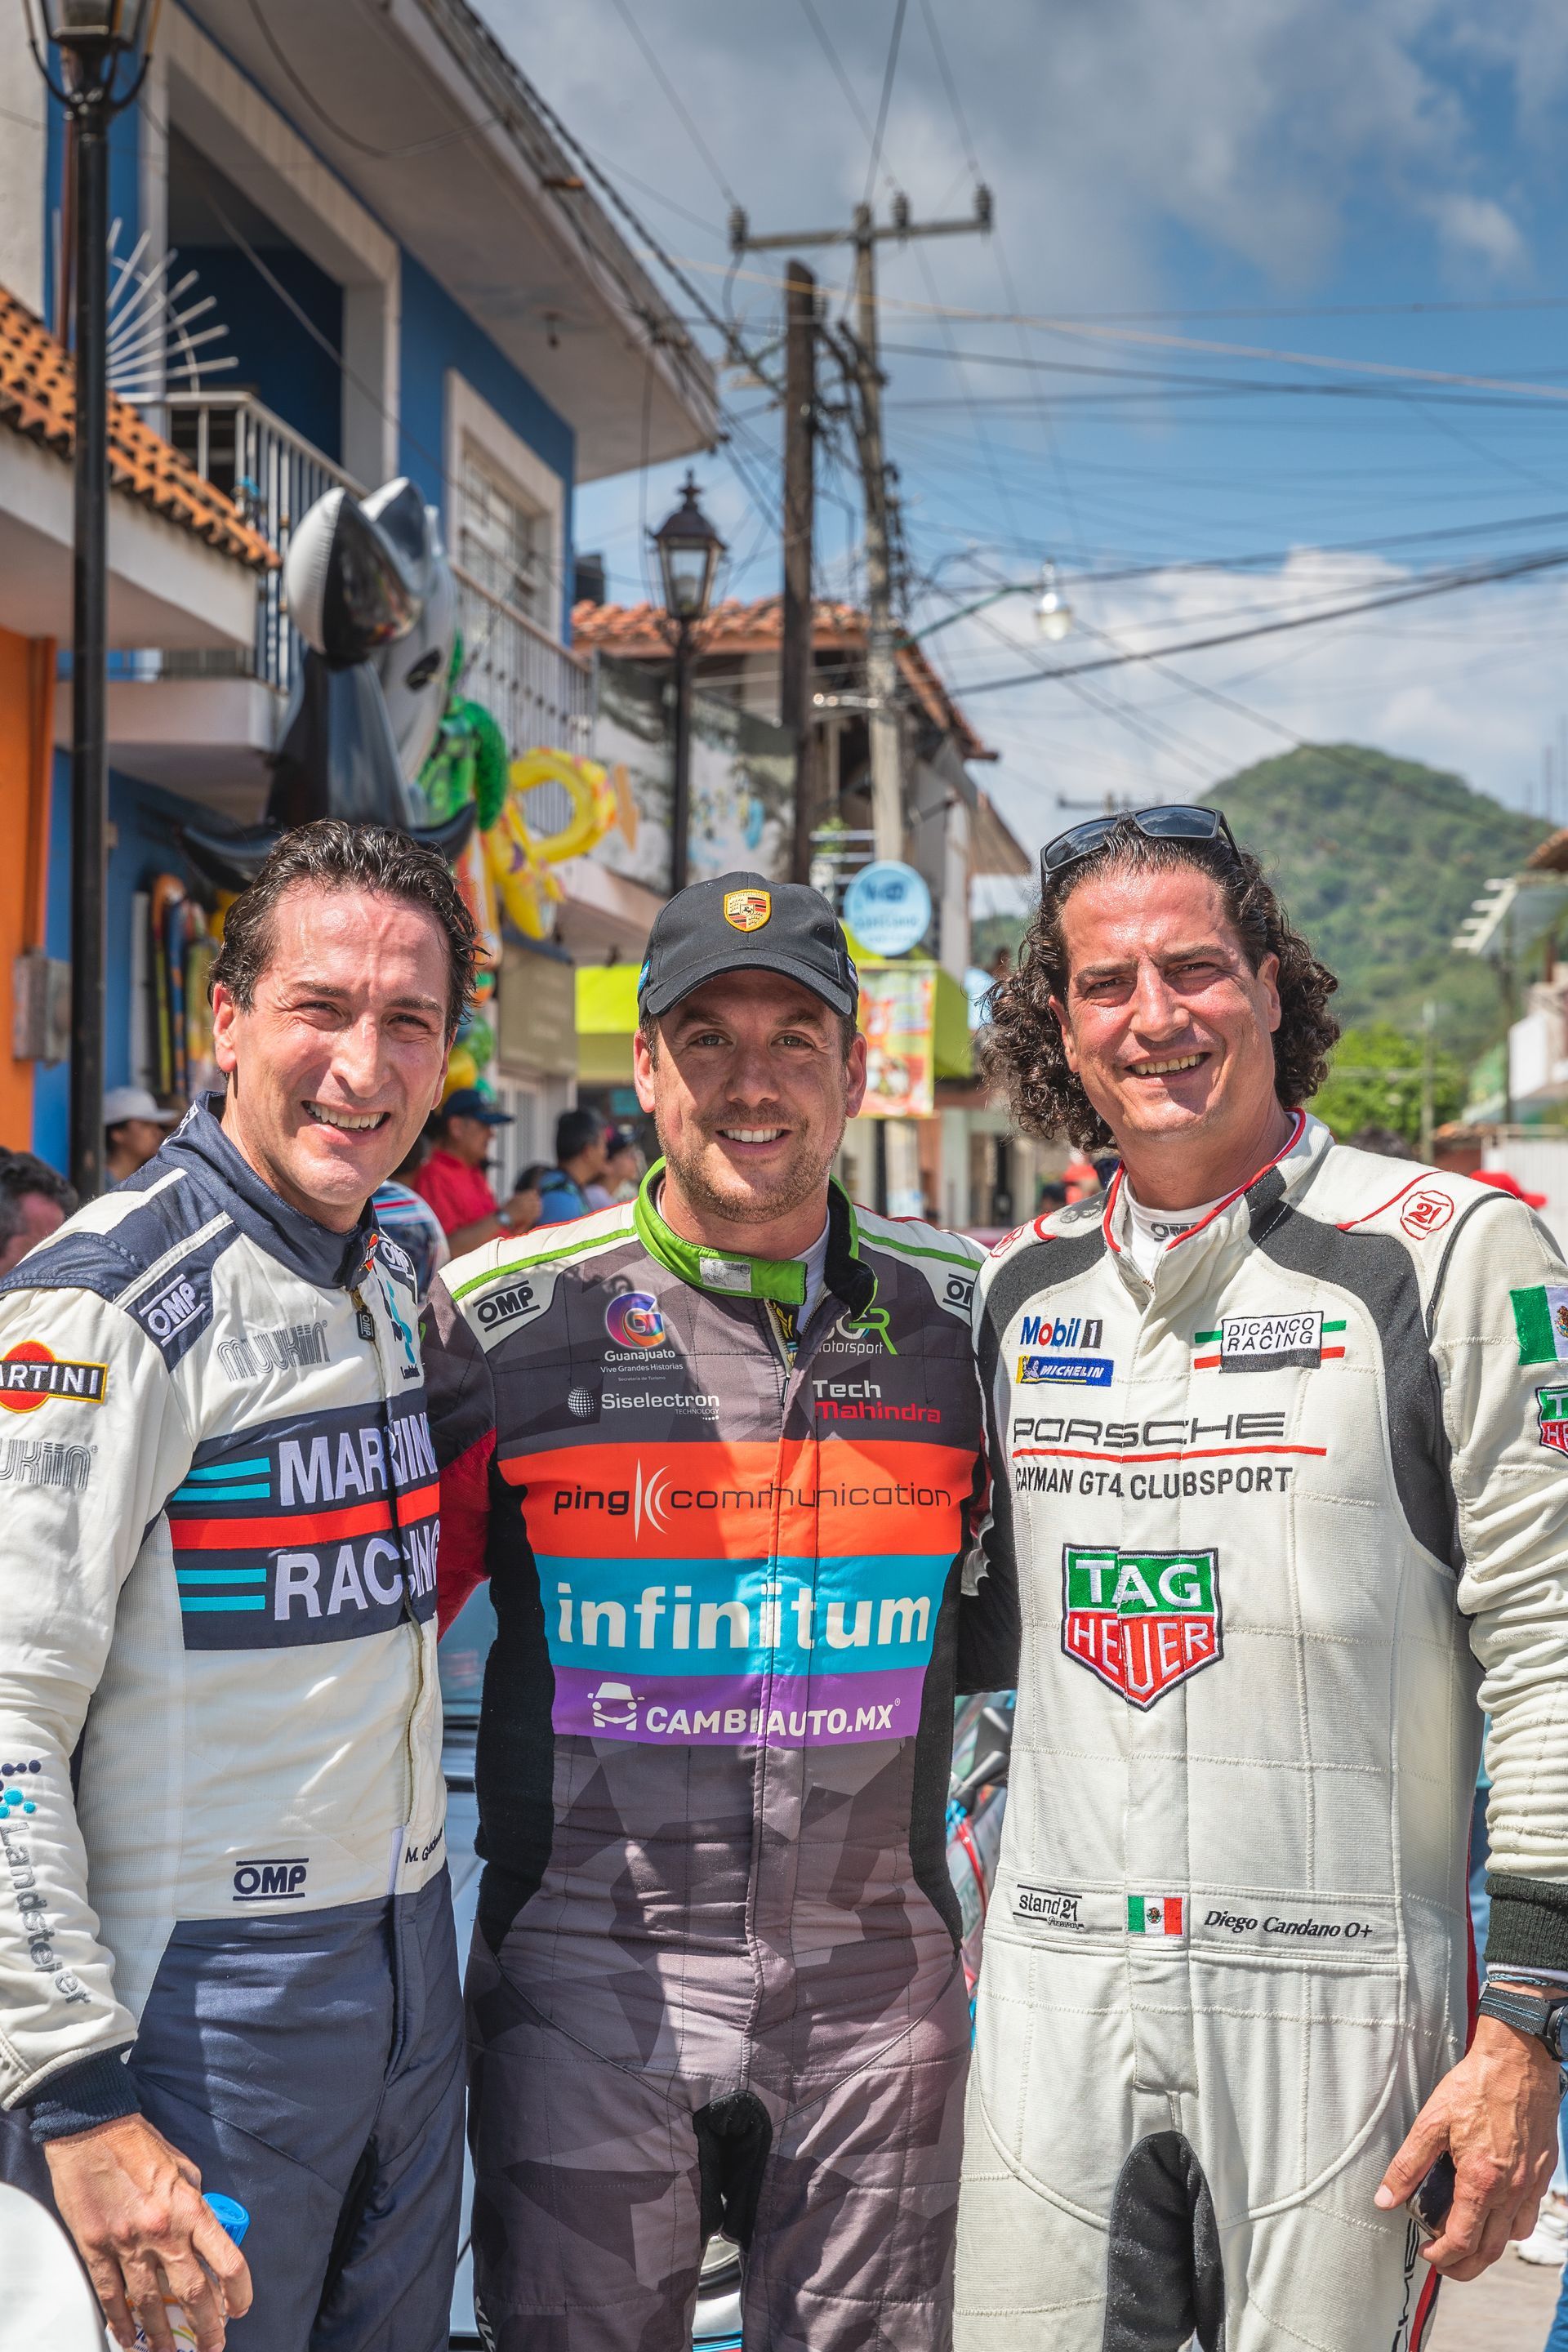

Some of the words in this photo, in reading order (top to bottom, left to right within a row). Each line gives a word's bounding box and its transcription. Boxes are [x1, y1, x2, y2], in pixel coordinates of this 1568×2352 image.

[1409, 1202, 1442, 1223] 21
[147, 1282, 197, 1337] OMP
[477, 1285, 535, 1324] OMP
[362, 1314, 372, 1338] OMP
[1019, 1316, 1081, 1348] Mobil
[1087, 1321, 1099, 1348] 1
[1227, 1317, 1315, 1338] DICANCO
[1227, 1330, 1313, 1352] RACING
[600, 1365, 617, 1374] Vive
[618, 1364, 650, 1373] Grandes
[650, 1363, 684, 1371] Historias
[604, 1349, 676, 1362] Guanajuato
[1040, 1365, 1105, 1379] MICHELIN
[601, 1392, 720, 1410] Siselectron
[813, 1379, 882, 1399] Tech
[815, 1401, 942, 1423] Mahindra
[1013, 1411, 1285, 1448] PORSCHE
[1015, 1466, 1073, 1494] CAYMAN
[1080, 1471, 1123, 1498] GT4
[1129, 1466, 1294, 1500] CLUBSPORT
[554, 1485, 630, 1517] ping
[670, 1481, 951, 1510] communication
[1076, 1558, 1201, 1608] TAG
[557, 1582, 931, 1650] infinitum
[1072, 1618, 1209, 1693] HEUER
[234, 1864, 307, 1895] OMP
[1205, 1910, 1258, 1933] Diego
[1263, 1916, 1341, 1938] Candano
[1344, 1922, 1373, 1938] O+
